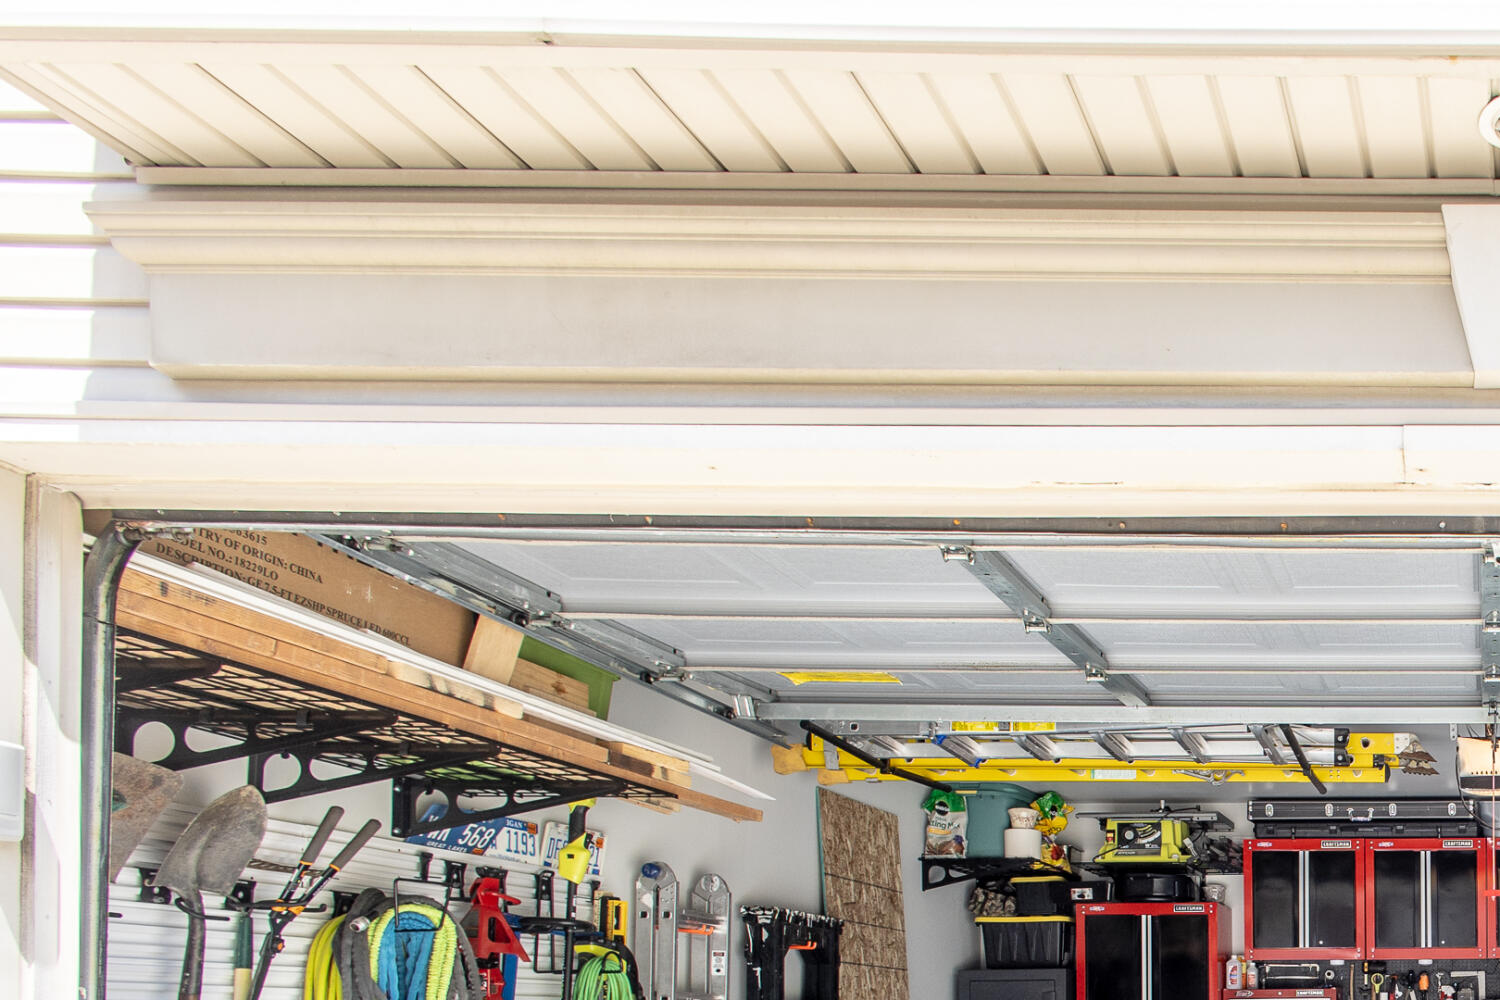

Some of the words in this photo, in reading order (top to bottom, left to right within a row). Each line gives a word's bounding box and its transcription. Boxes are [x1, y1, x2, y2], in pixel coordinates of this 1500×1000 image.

[223, 537, 241, 551] OF
[242, 543, 288, 570] ORIGIN:
[289, 562, 324, 584] CHINA
[326, 605, 362, 628] SPRUCE
[457, 823, 496, 849] 568
[505, 829, 536, 857] 1193
